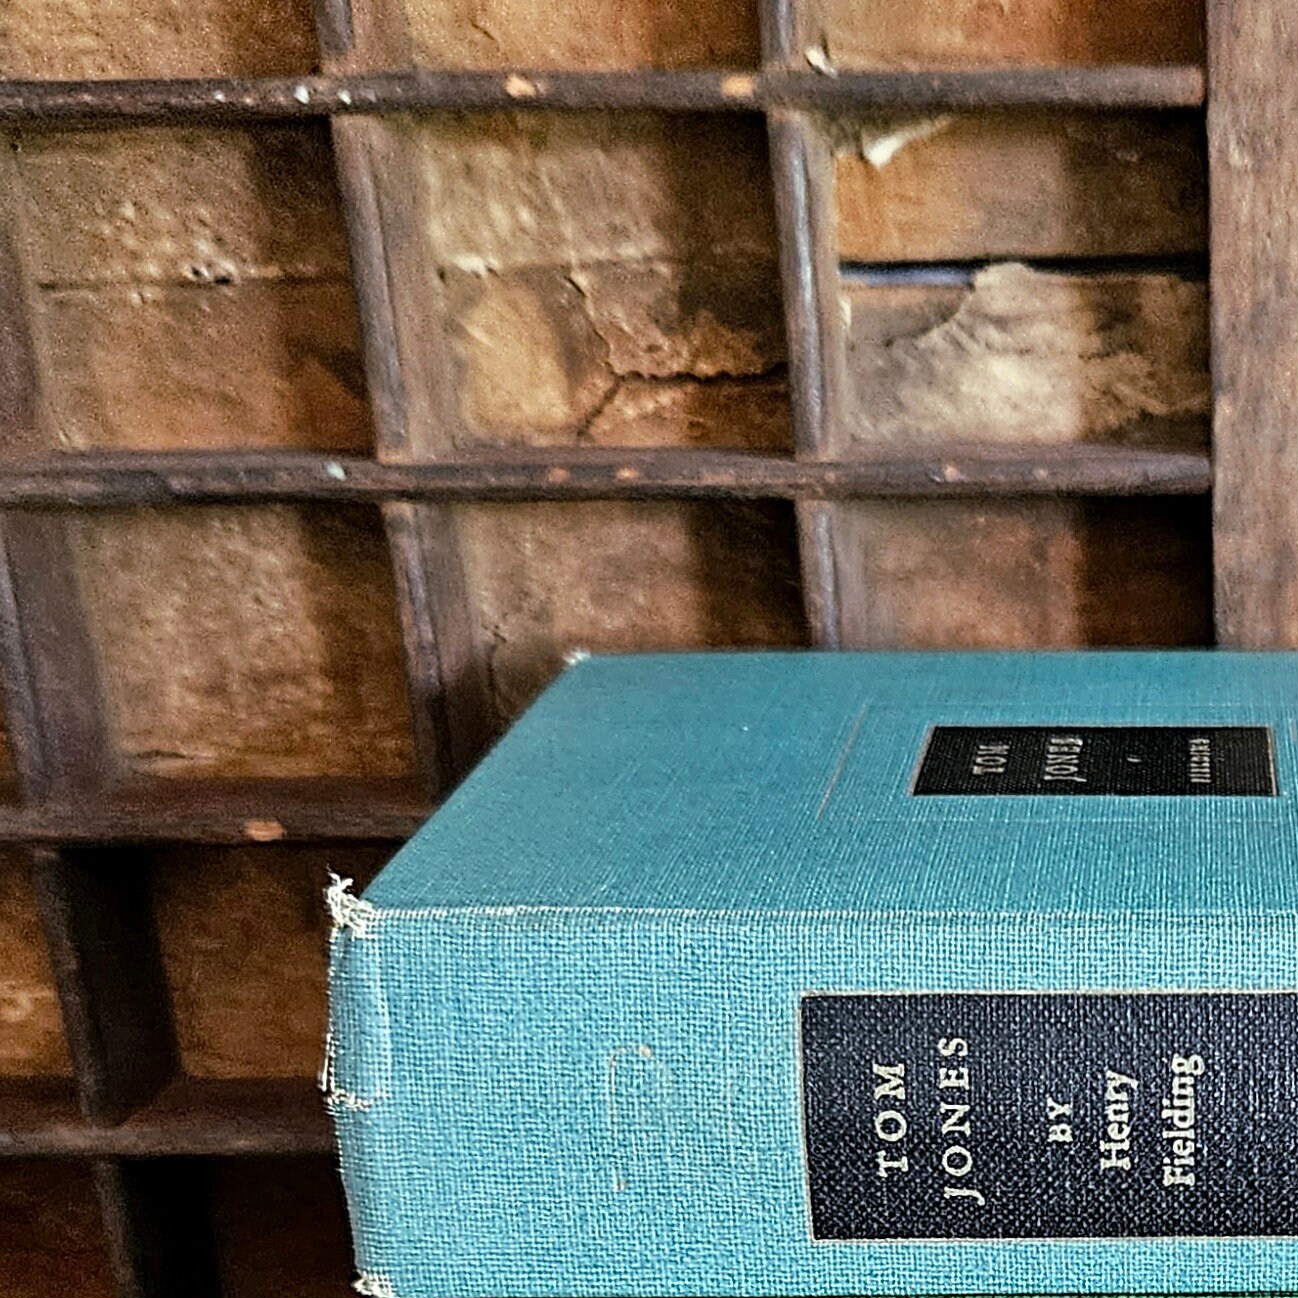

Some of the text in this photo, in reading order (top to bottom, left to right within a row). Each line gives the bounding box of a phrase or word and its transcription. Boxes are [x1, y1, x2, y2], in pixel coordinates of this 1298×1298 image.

[874, 1061, 908, 1177] TOM
[938, 1035, 985, 1204] JONES
[1048, 1098, 1075, 1143] BY
[1101, 1069, 1140, 1171] Henry
[1163, 1053, 1205, 1189] Fielding
